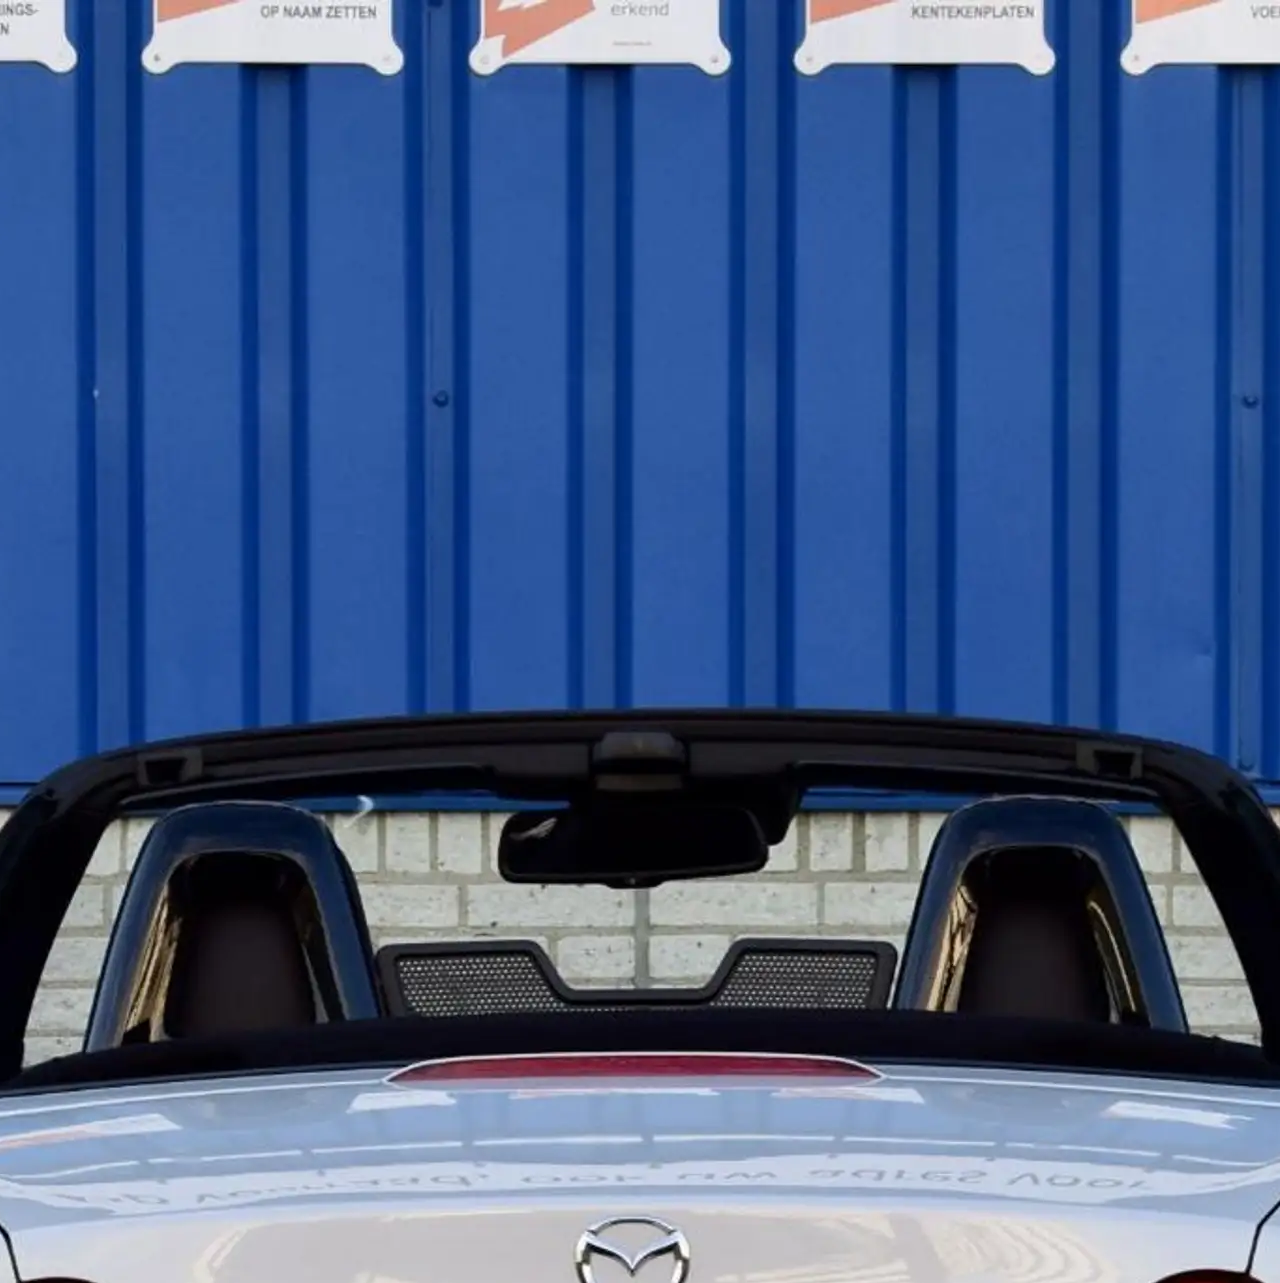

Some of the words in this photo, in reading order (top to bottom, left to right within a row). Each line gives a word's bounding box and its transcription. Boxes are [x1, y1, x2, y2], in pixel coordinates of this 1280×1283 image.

[260, 5, 279, 18] OP
[283, 5, 322, 18] NAAM
[325, 5, 377, 18] ZETTEN
[611, 2, 670, 16] erkend
[911, 5, 1035, 18] KENTEKENPLATEN
